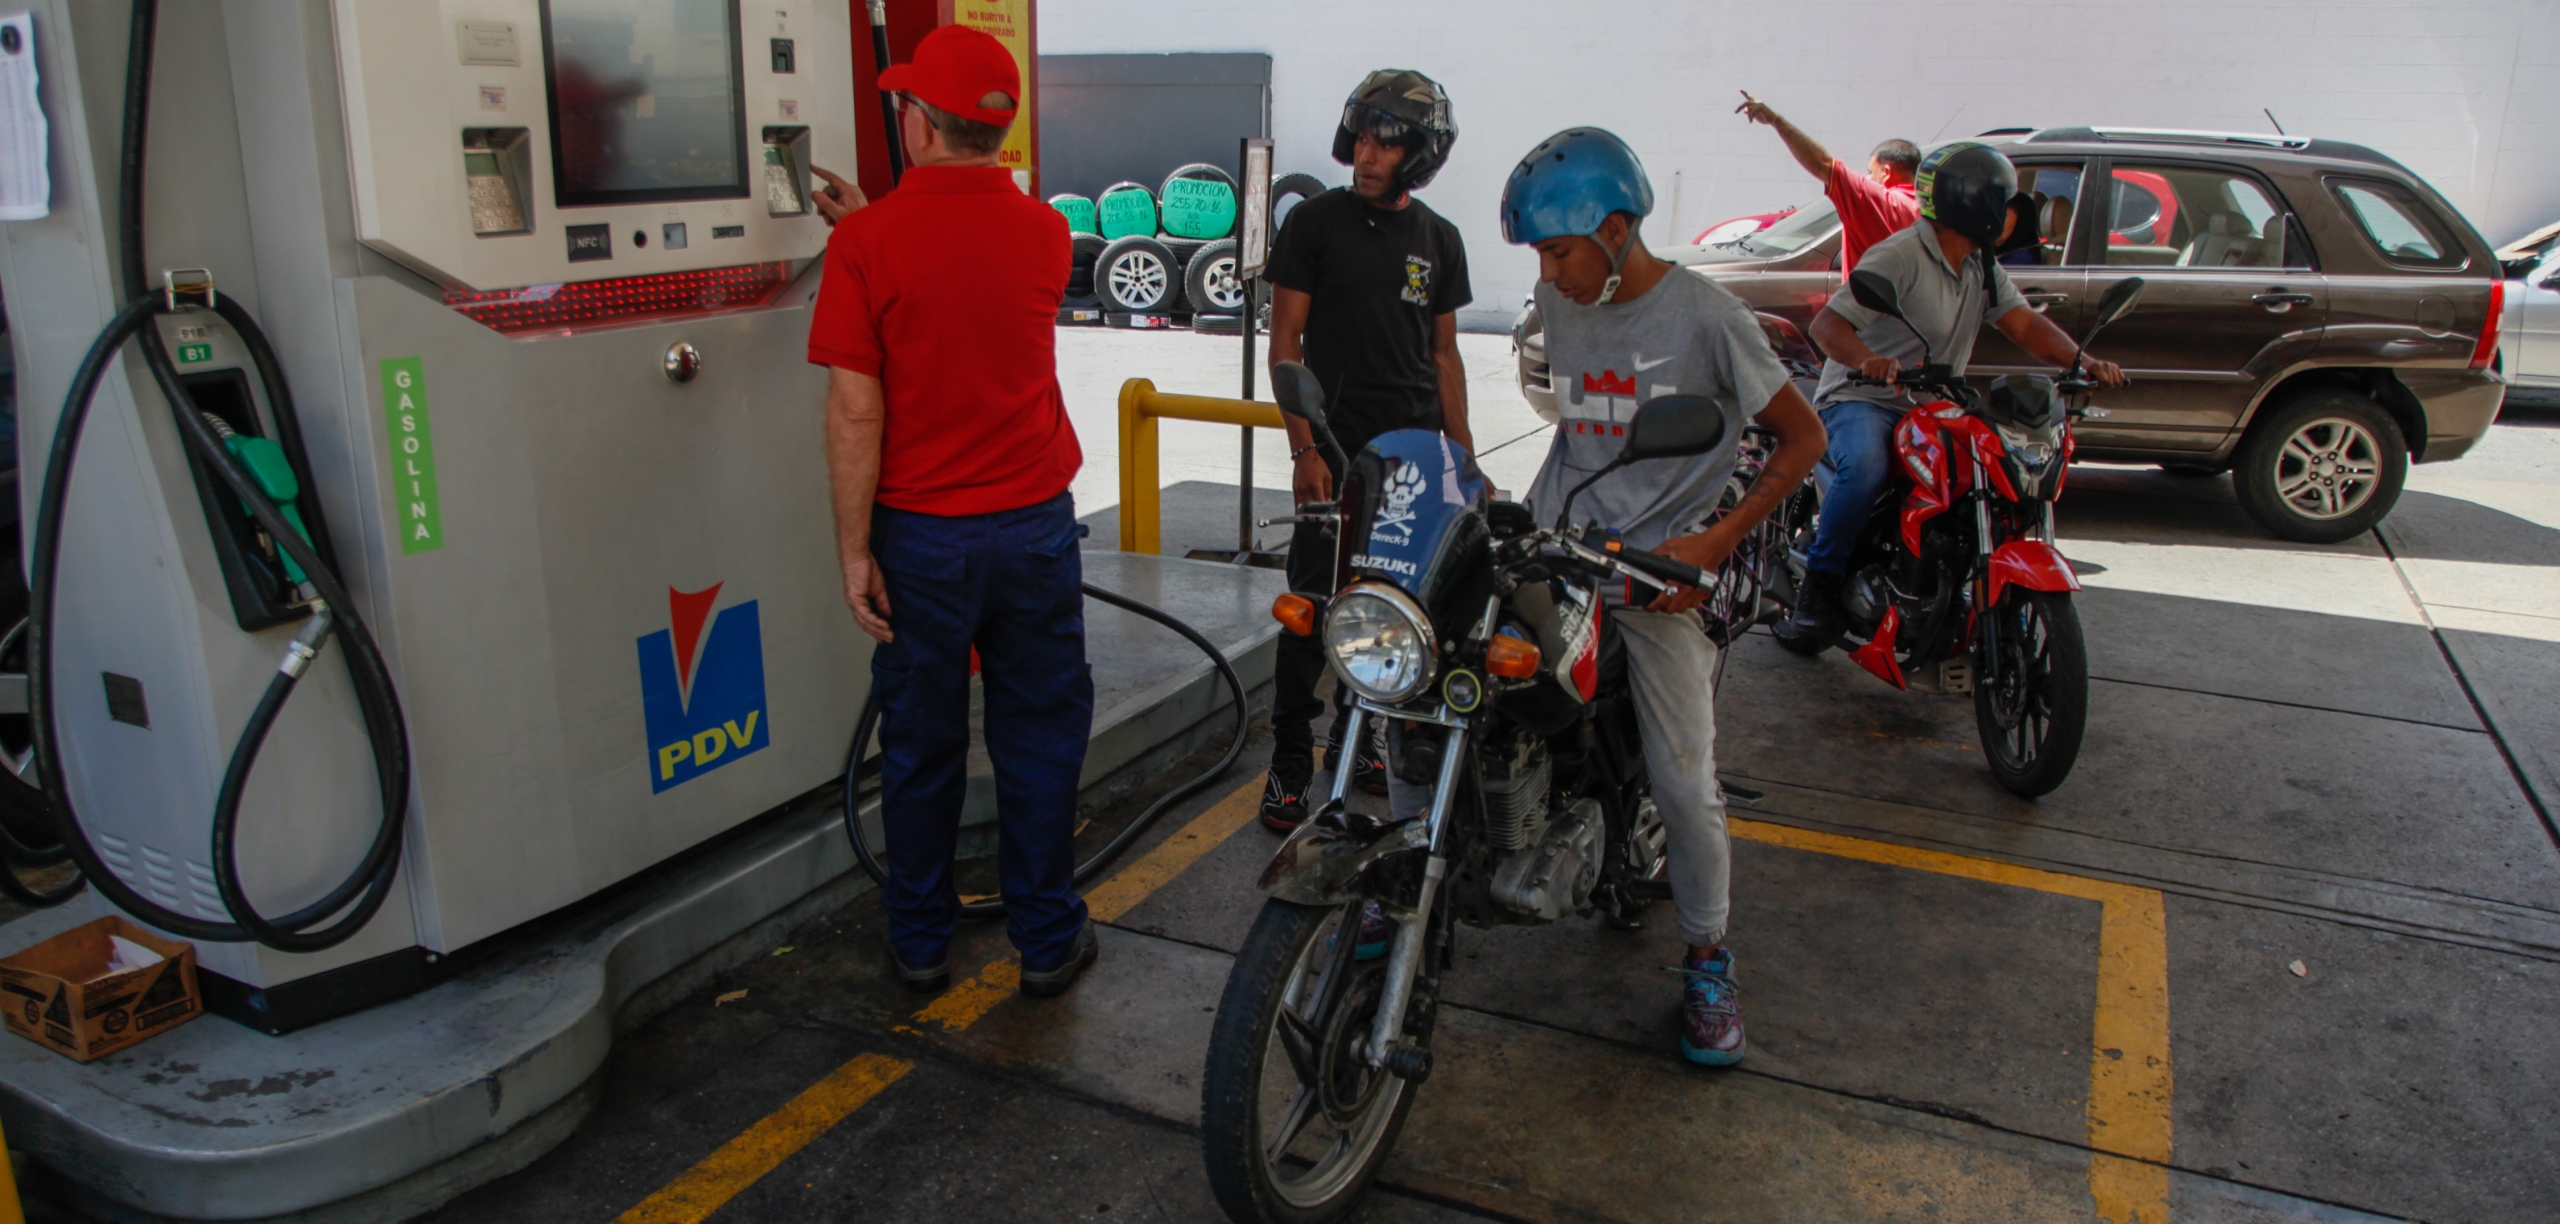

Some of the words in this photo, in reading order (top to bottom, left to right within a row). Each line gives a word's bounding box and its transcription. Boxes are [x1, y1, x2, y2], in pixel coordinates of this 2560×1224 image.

[967, 11, 978, 21] NO
[980, 12, 1005, 24] SURTIR
[1007, 15, 1012, 24] A
[998, 150, 1022, 163] IDAD
[577, 237, 598, 249] NFC
[1406, 253, 1432, 269] JORDAN
[186, 347, 206, 361] B1
[395, 370, 430, 541] GASOLINA
[1350, 554, 1417, 576] SUZUKI
[658, 709, 760, 782] PDV
